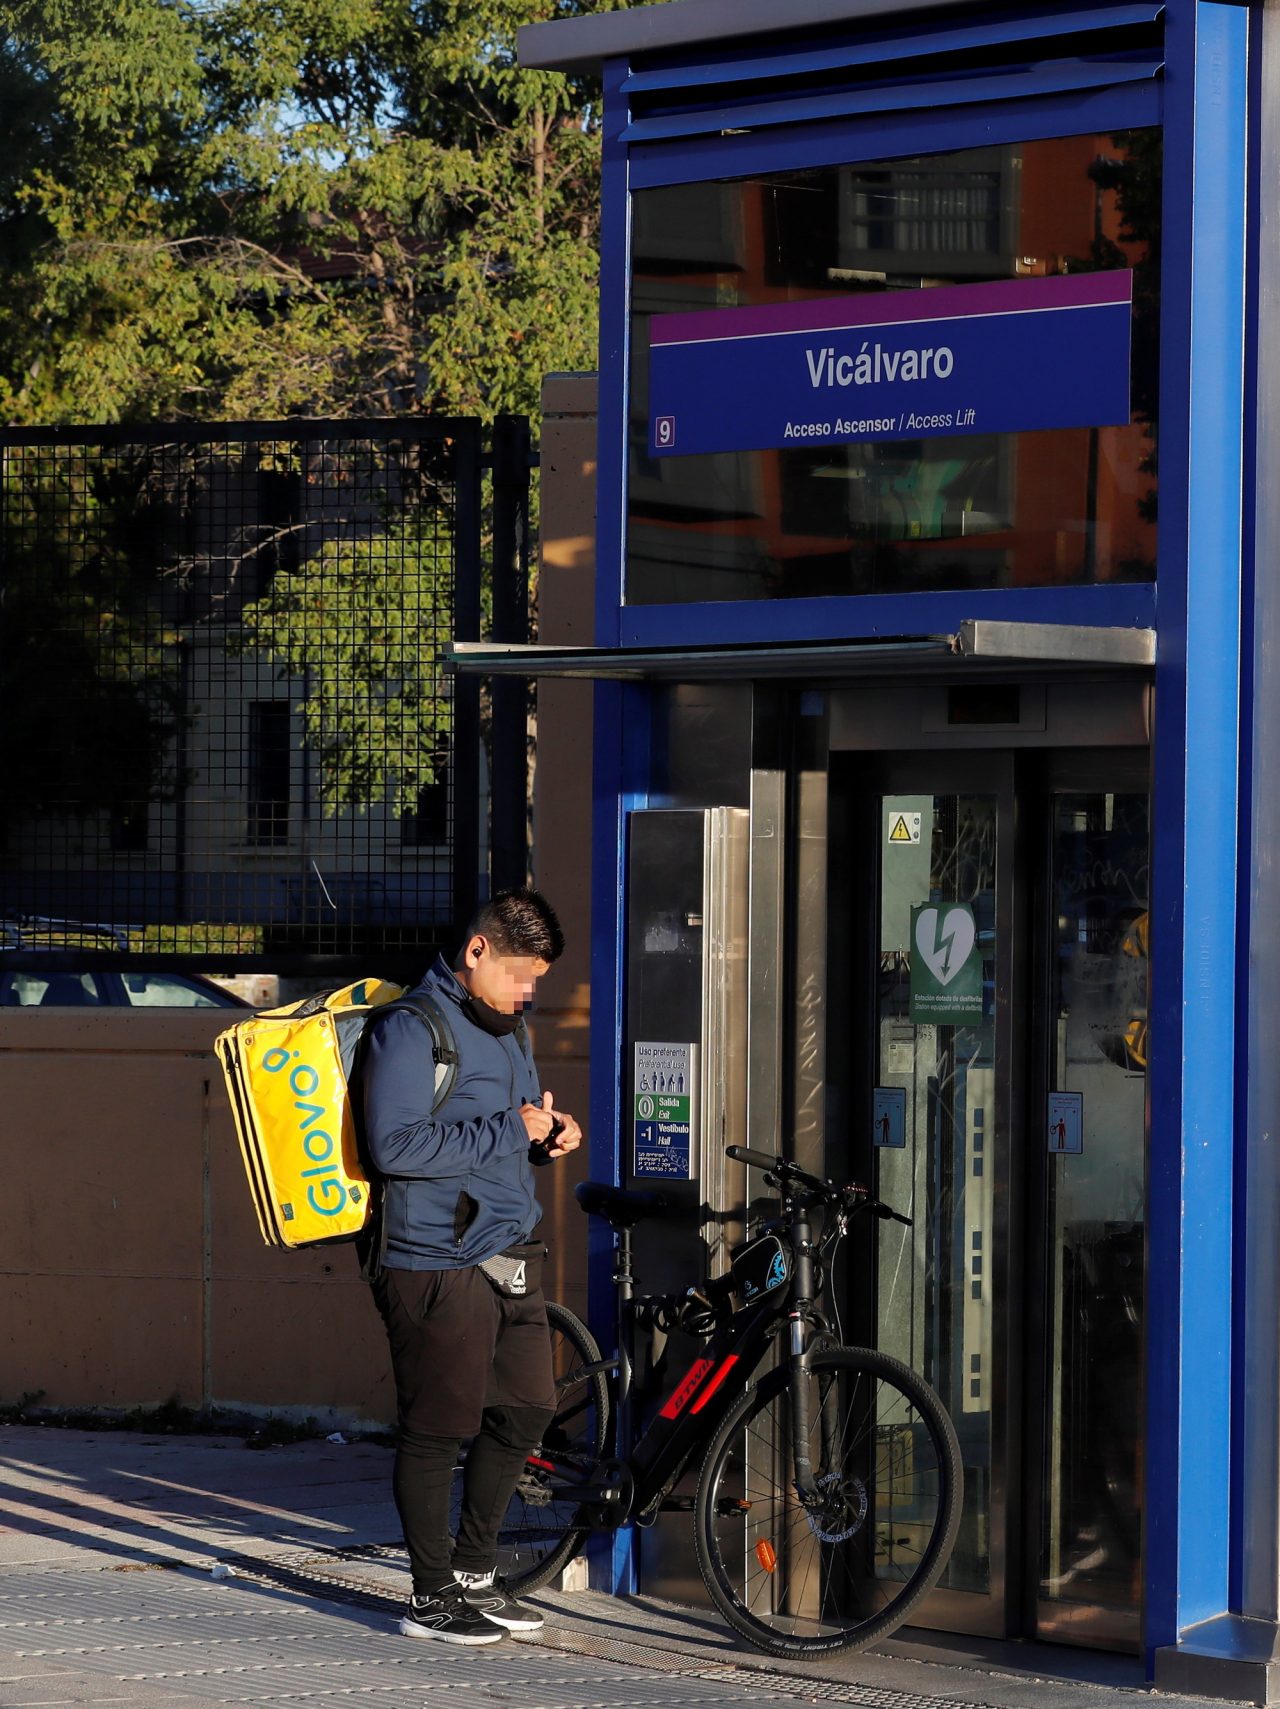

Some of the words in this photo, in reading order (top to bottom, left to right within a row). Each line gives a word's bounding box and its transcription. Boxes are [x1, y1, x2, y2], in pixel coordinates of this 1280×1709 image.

[805, 342, 954, 388] Vicálvaro
[659, 420, 671, 443] 9
[783, 420, 831, 438] Acceso
[834, 416, 896, 435] Ascensor
[898, 413, 904, 432] /
[906, 411, 953, 430] Access
[956, 408, 976, 427] Lift
[639, 1046, 652, 1056] Uso
[653, 1047, 687, 1058] preferente
[658, 1097, 680, 1107] Salida
[658, 1110, 670, 1119] Exit
[290, 1064, 347, 1216] Glovo
[641, 1126, 652, 1141] -1
[658, 1123, 689, 1134] Vestíbulo
[658, 1136, 671, 1146] Hall
